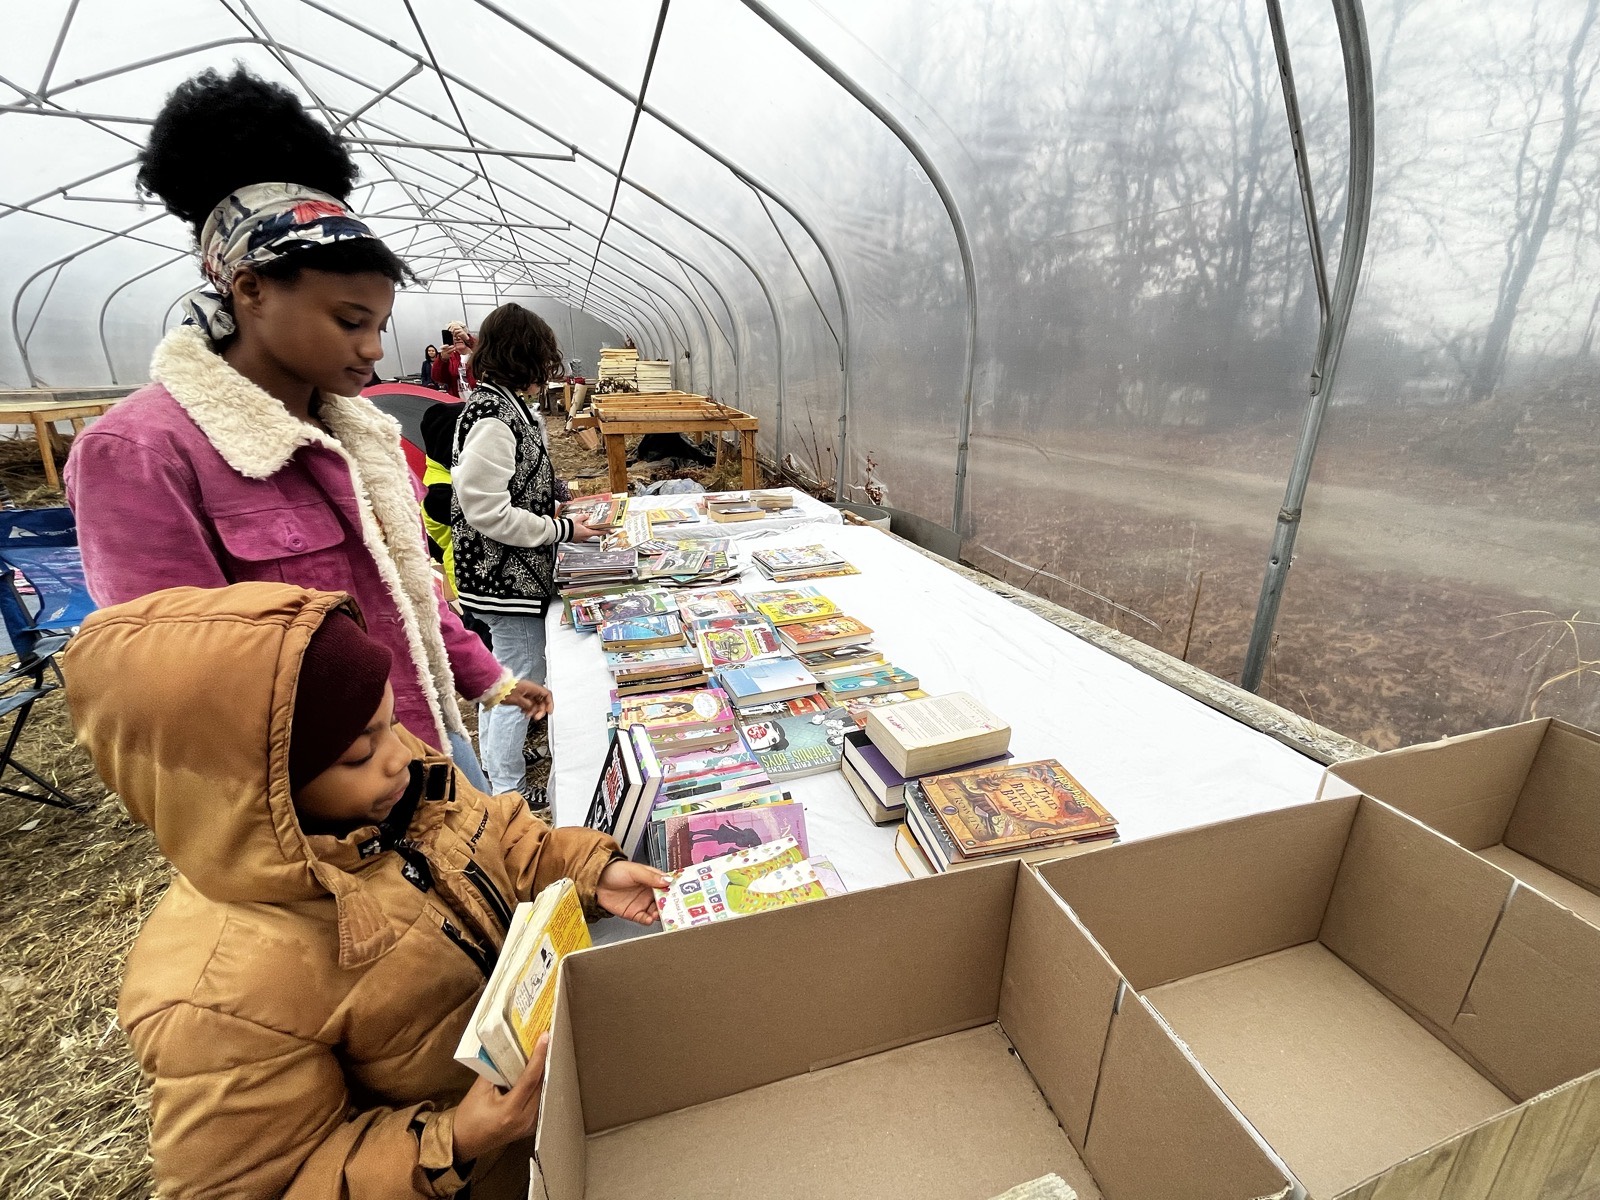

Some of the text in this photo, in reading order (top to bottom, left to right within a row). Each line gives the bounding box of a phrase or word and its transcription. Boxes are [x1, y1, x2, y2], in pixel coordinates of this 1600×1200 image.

[760, 752, 790, 768] BOYS
[766, 755, 837, 774] FAITH ERIN HICKS
[791, 744, 834, 763] FRIENDS
[1000, 789, 1028, 813] BARD
[1010, 782, 1041, 809] BEEDLE
[1053, 774, 1091, 809] Harry Potter
[954, 797, 987, 835] ROWLING
[470, 825, 485, 845] FREE
